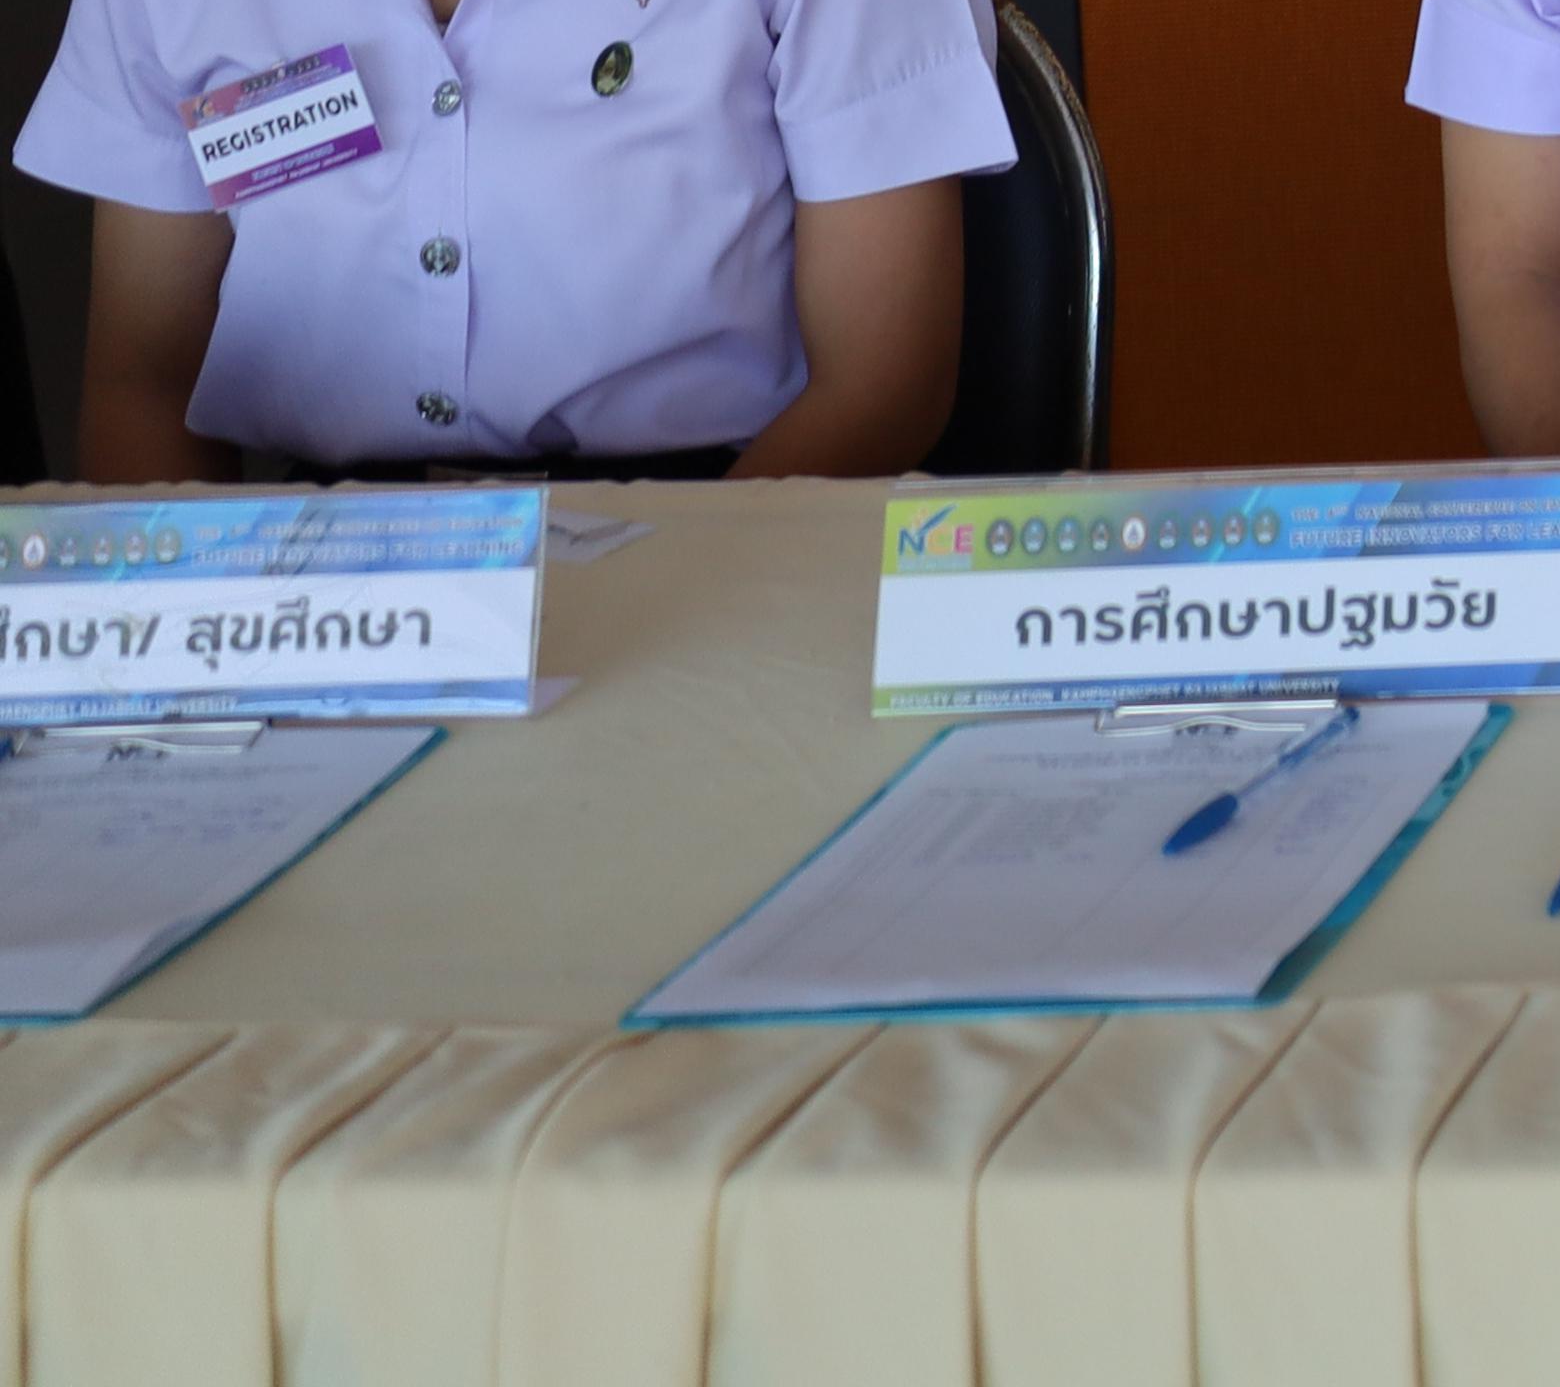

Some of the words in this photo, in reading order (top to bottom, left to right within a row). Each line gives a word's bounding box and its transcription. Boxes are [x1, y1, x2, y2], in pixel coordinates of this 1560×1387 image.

[202, 89, 359, 164] REGISTRATION
[185, 596, 432, 673] สุขศึกษา
[1015, 577, 1498, 650] การศึกษาปฐมวัย
